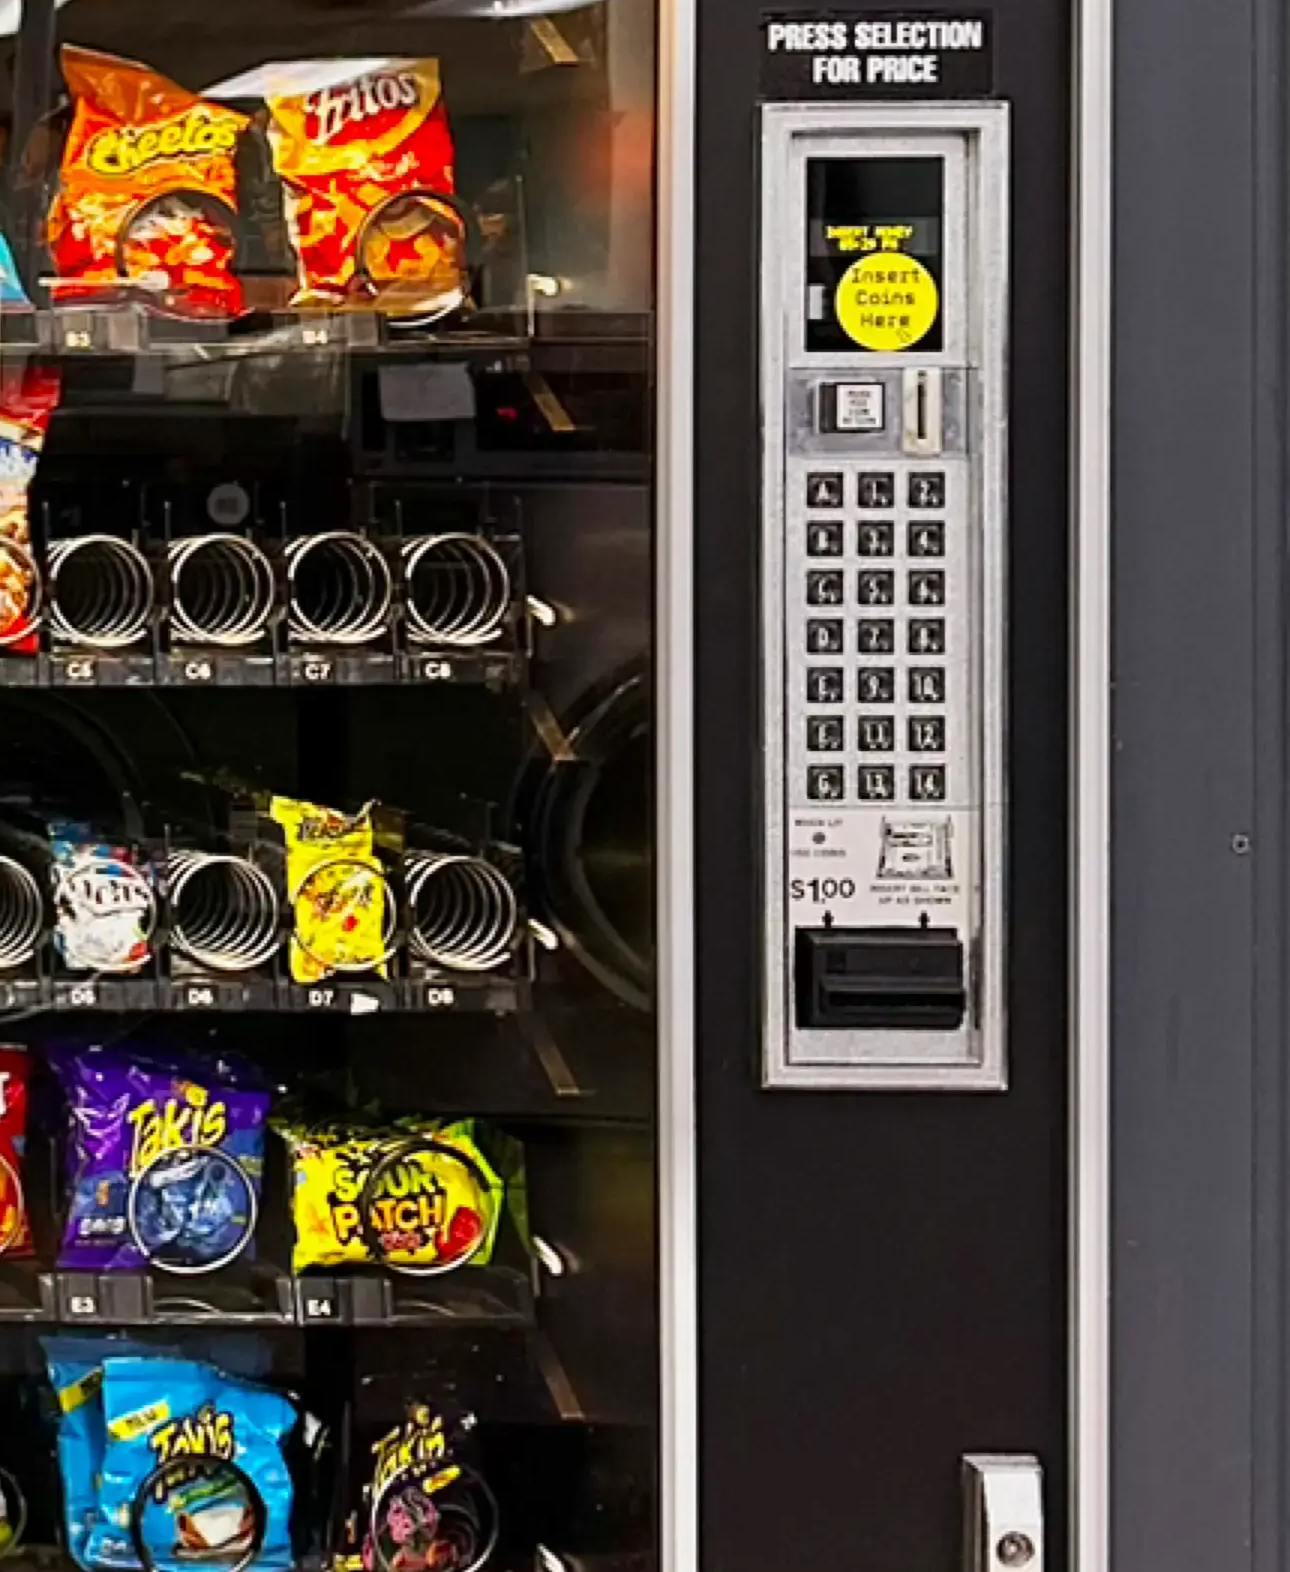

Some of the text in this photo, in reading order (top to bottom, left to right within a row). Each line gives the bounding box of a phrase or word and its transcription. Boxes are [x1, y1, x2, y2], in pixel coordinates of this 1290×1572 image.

[768, 21, 983, 50] PRESS SELECTION
[812, 55, 939, 84] FOR PRICE
[305, 70, 421, 145] Fritos
[87, 108, 240, 174] Cheetos
[851, 268, 920, 283] Insert
[855, 289, 916, 305] Coins
[860, 313, 910, 327] Here
[127, 1095, 228, 1178] Takis
